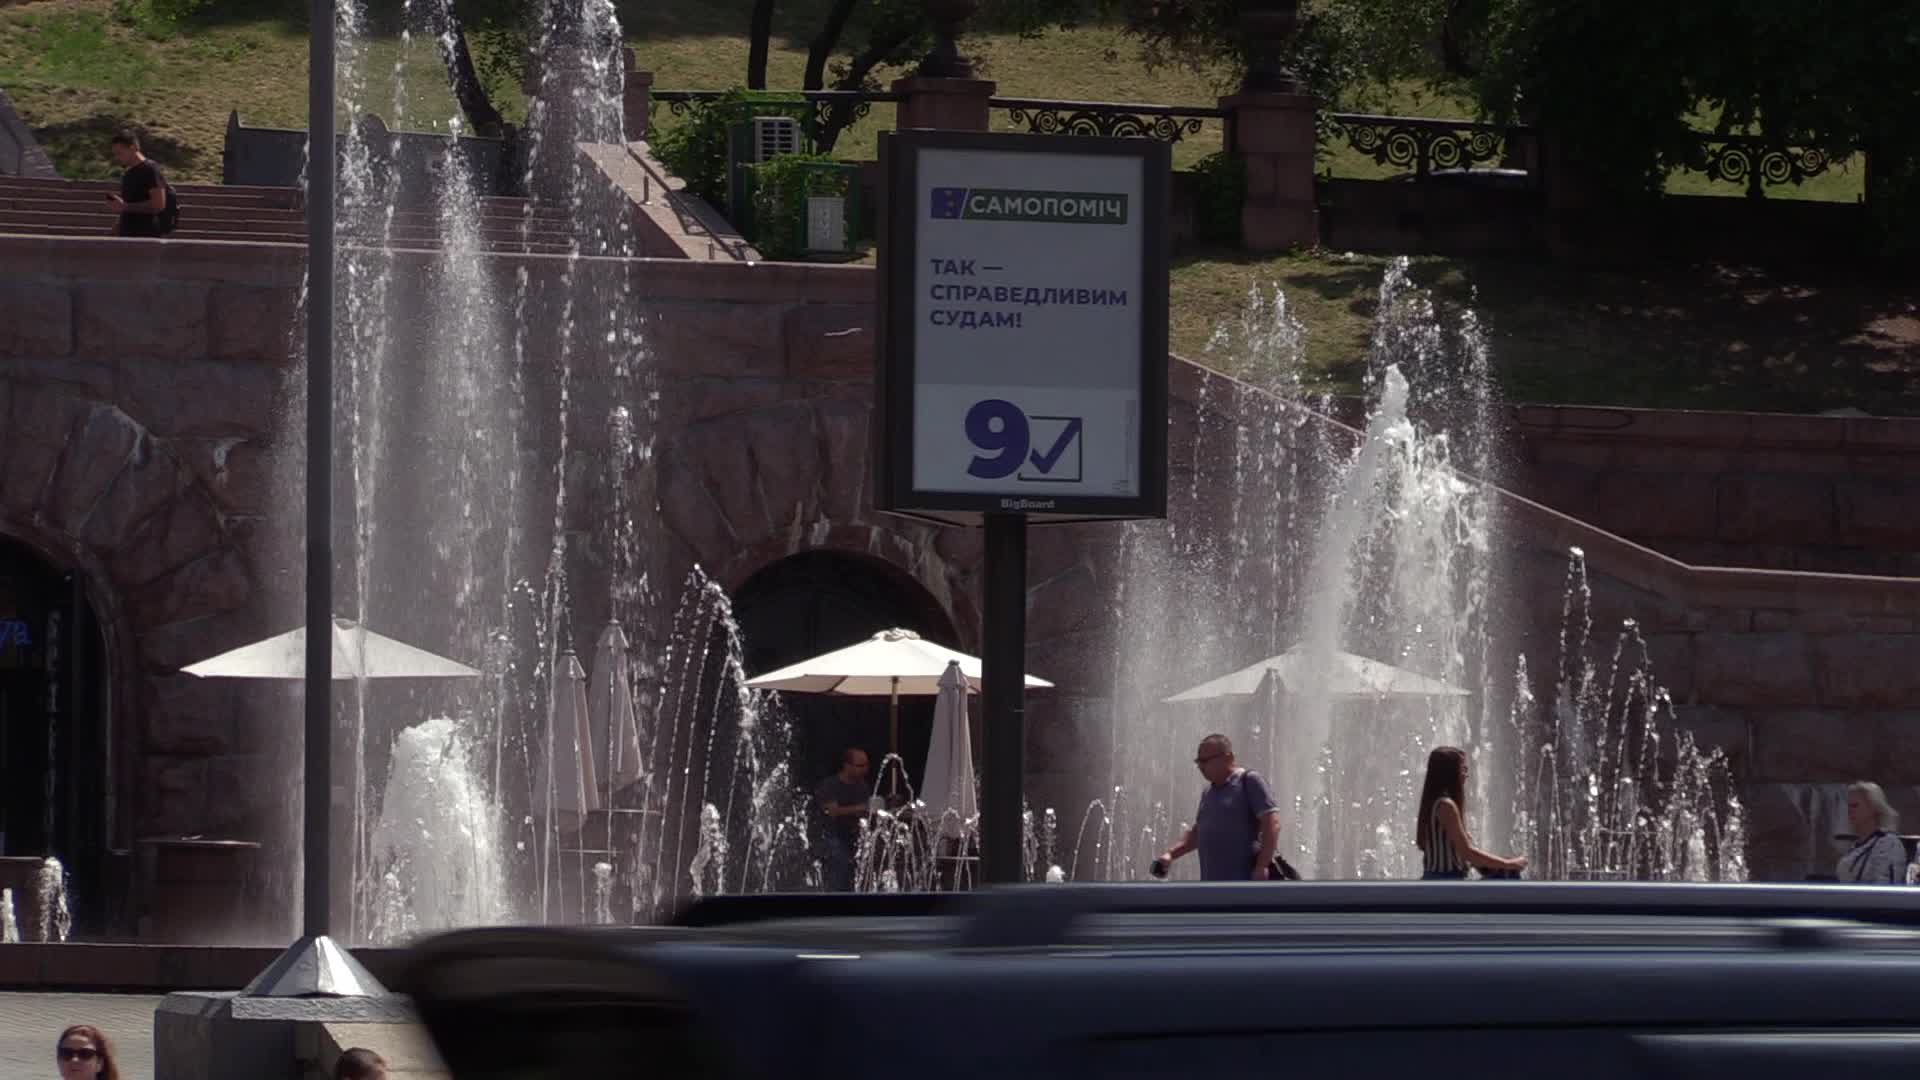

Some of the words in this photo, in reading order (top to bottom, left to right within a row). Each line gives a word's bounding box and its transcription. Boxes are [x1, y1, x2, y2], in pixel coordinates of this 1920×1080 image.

[969, 195, 1122, 218] САМОПОМІЧ
[930, 258, 977, 276] ТАК
[930, 284, 1127, 307] СПРАВЕДЛИВИМ
[929, 310, 1023, 329] СУДАМ!
[964, 398, 1030, 480] 9
[1000, 499, 1056, 511] BigBoard
